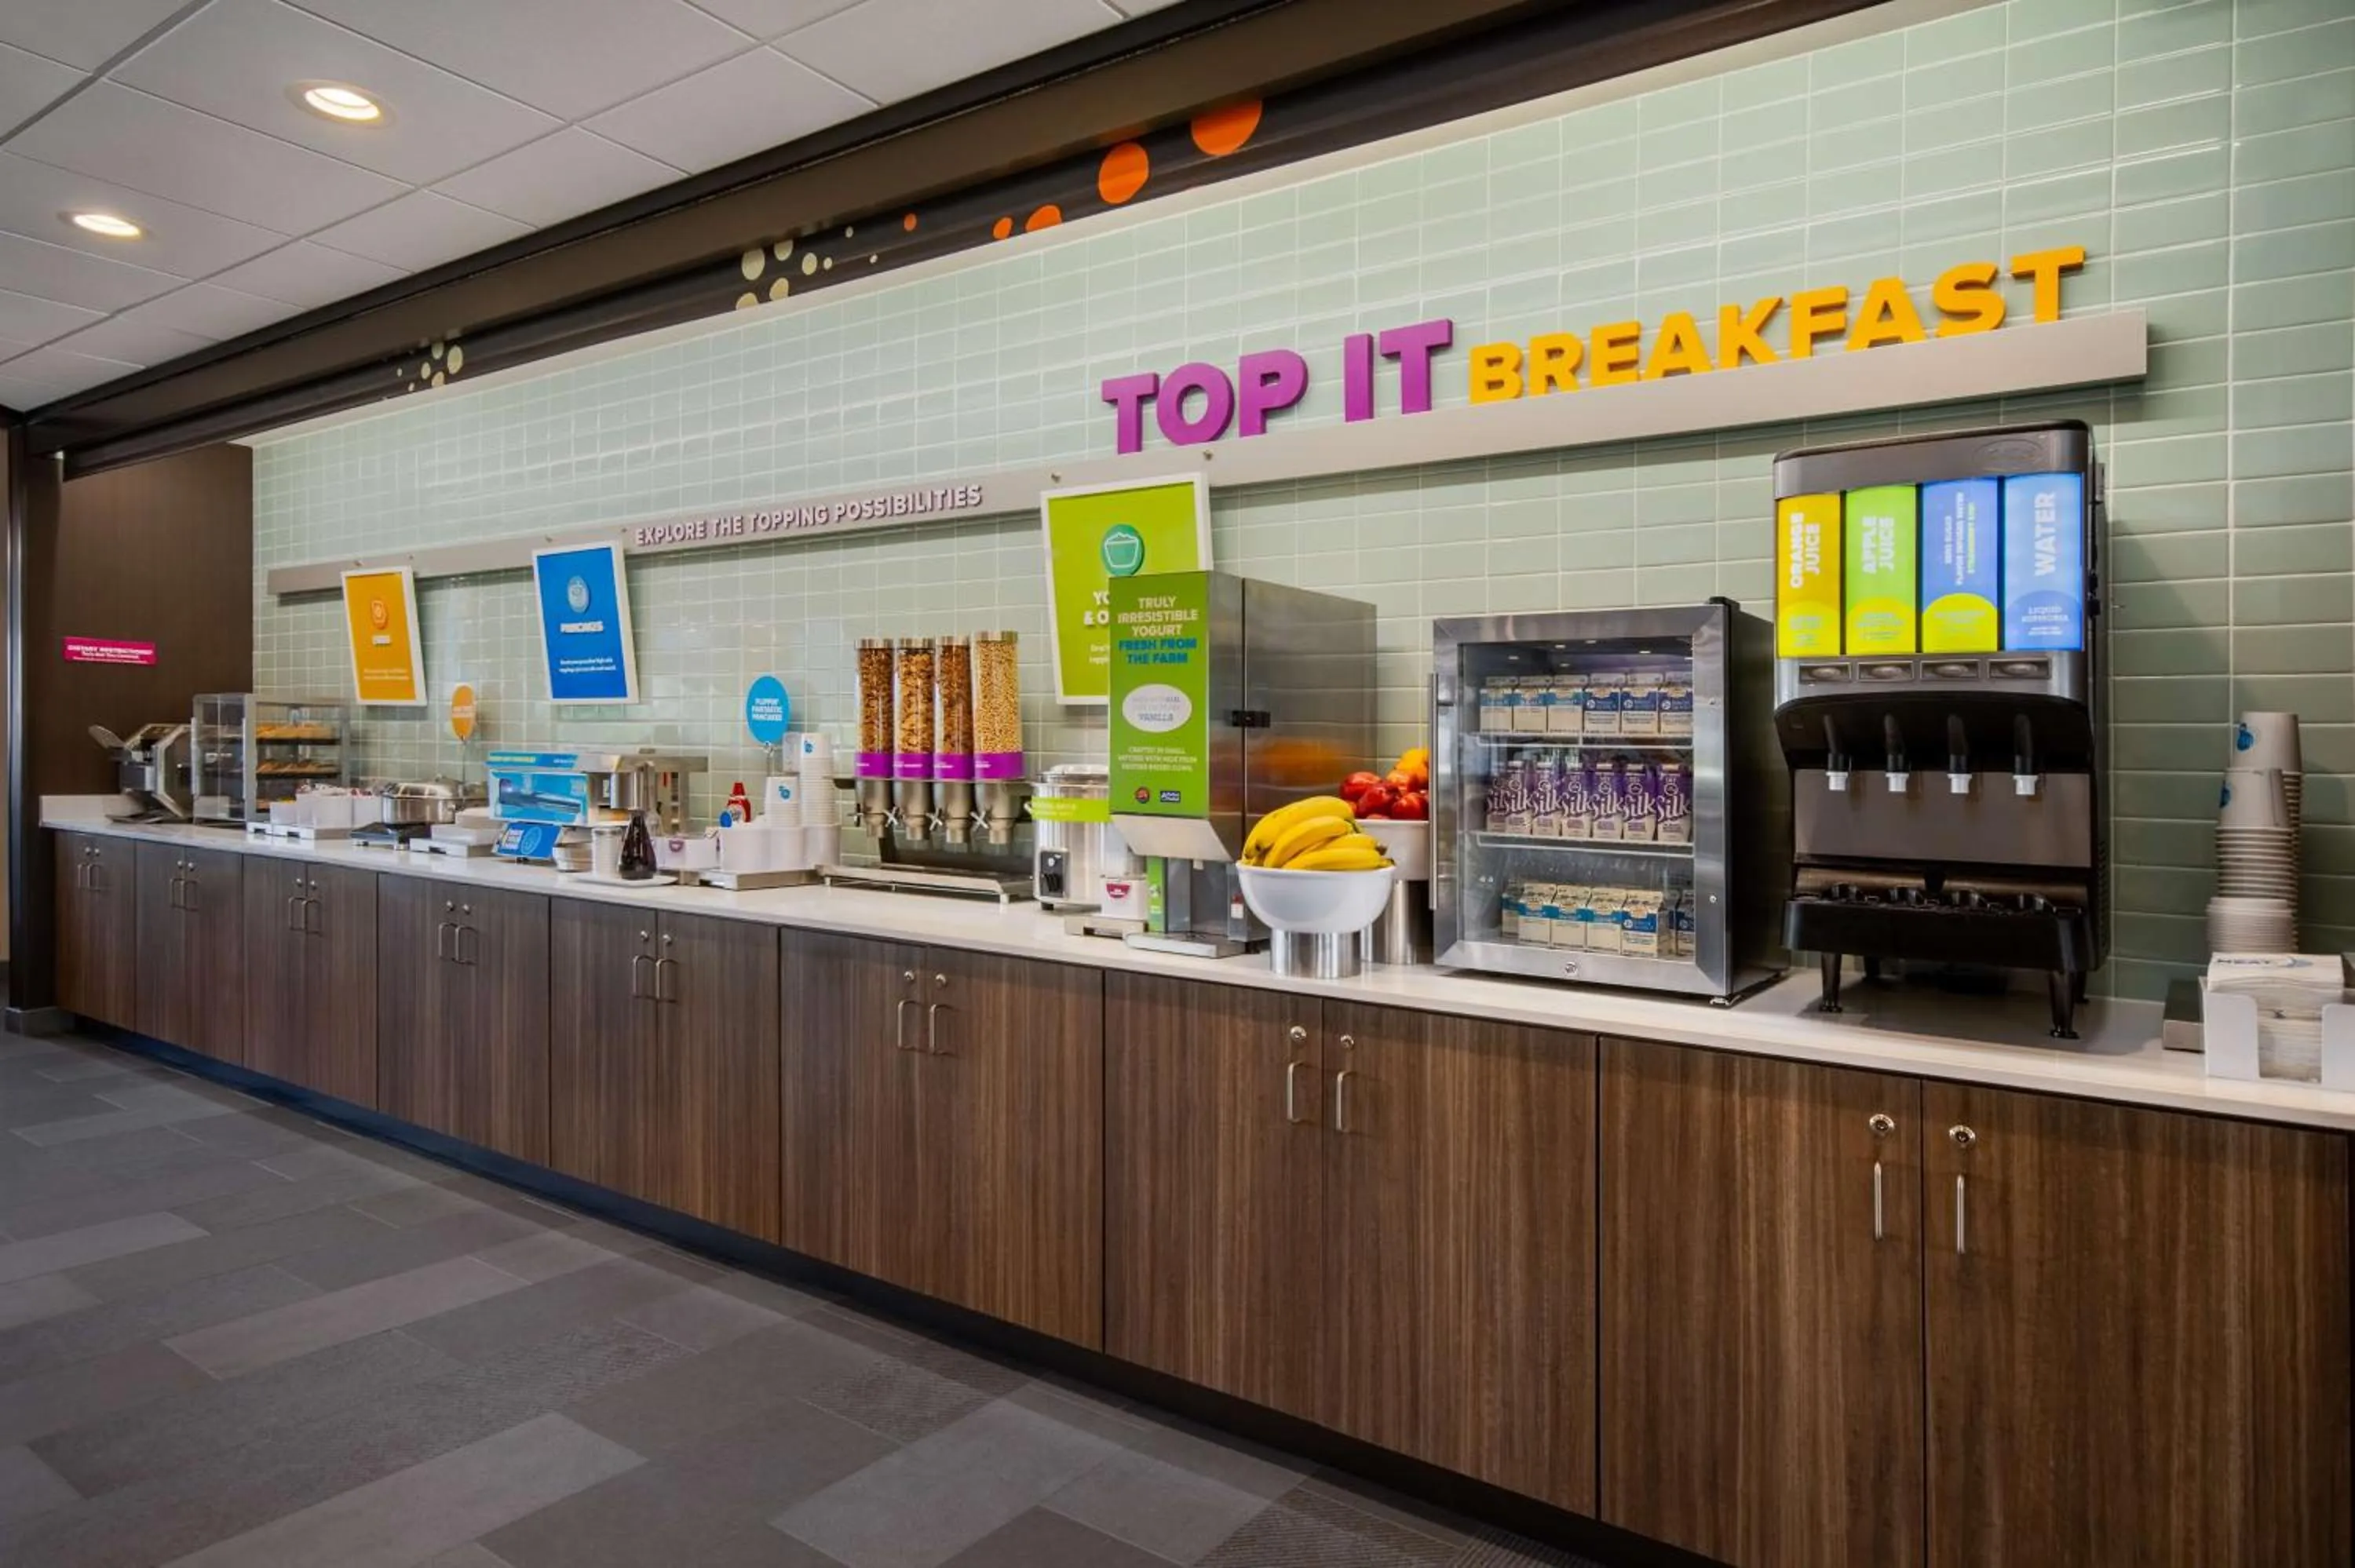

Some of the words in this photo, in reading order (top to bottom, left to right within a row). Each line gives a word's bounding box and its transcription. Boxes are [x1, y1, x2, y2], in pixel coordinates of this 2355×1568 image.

[1102, 349, 1309, 454] TOP
[1344, 318, 1453, 423] IT
[1469, 246, 2085, 405] BREAKFAST
[637, 520, 706, 546] EXPLORE
[711, 516, 744, 538] THE
[750, 505, 830, 533] TOPPING
[835, 484, 982, 523] POSSIBILITIES
[1862, 516, 1876, 574] APPLE
[1879, 517, 1894, 573] JUICE
[2035, 491, 2056, 576] WATER
[1790, 512, 1804, 589] ORANGE
[1806, 523, 1820, 575] JUICE
[1118, 609, 1199, 624] IRRESISTIBLE
[1138, 596, 1177, 609] TRULY
[1119, 640, 1156, 651] FRESH
[1161, 637, 1197, 650] FROM
[1132, 625, 1183, 637] YOGURT
[1128, 653, 1150, 664] THE
[1153, 652, 1188, 664] FARM
[1504, 788, 1532, 815] Silk
[1531, 789, 1561, 815] Silk
[1561, 789, 1592, 816] Silk
[1591, 791, 1624, 819] Silk
[1623, 792, 1656, 822] Silk
[1657, 793, 1691, 823] Silk
